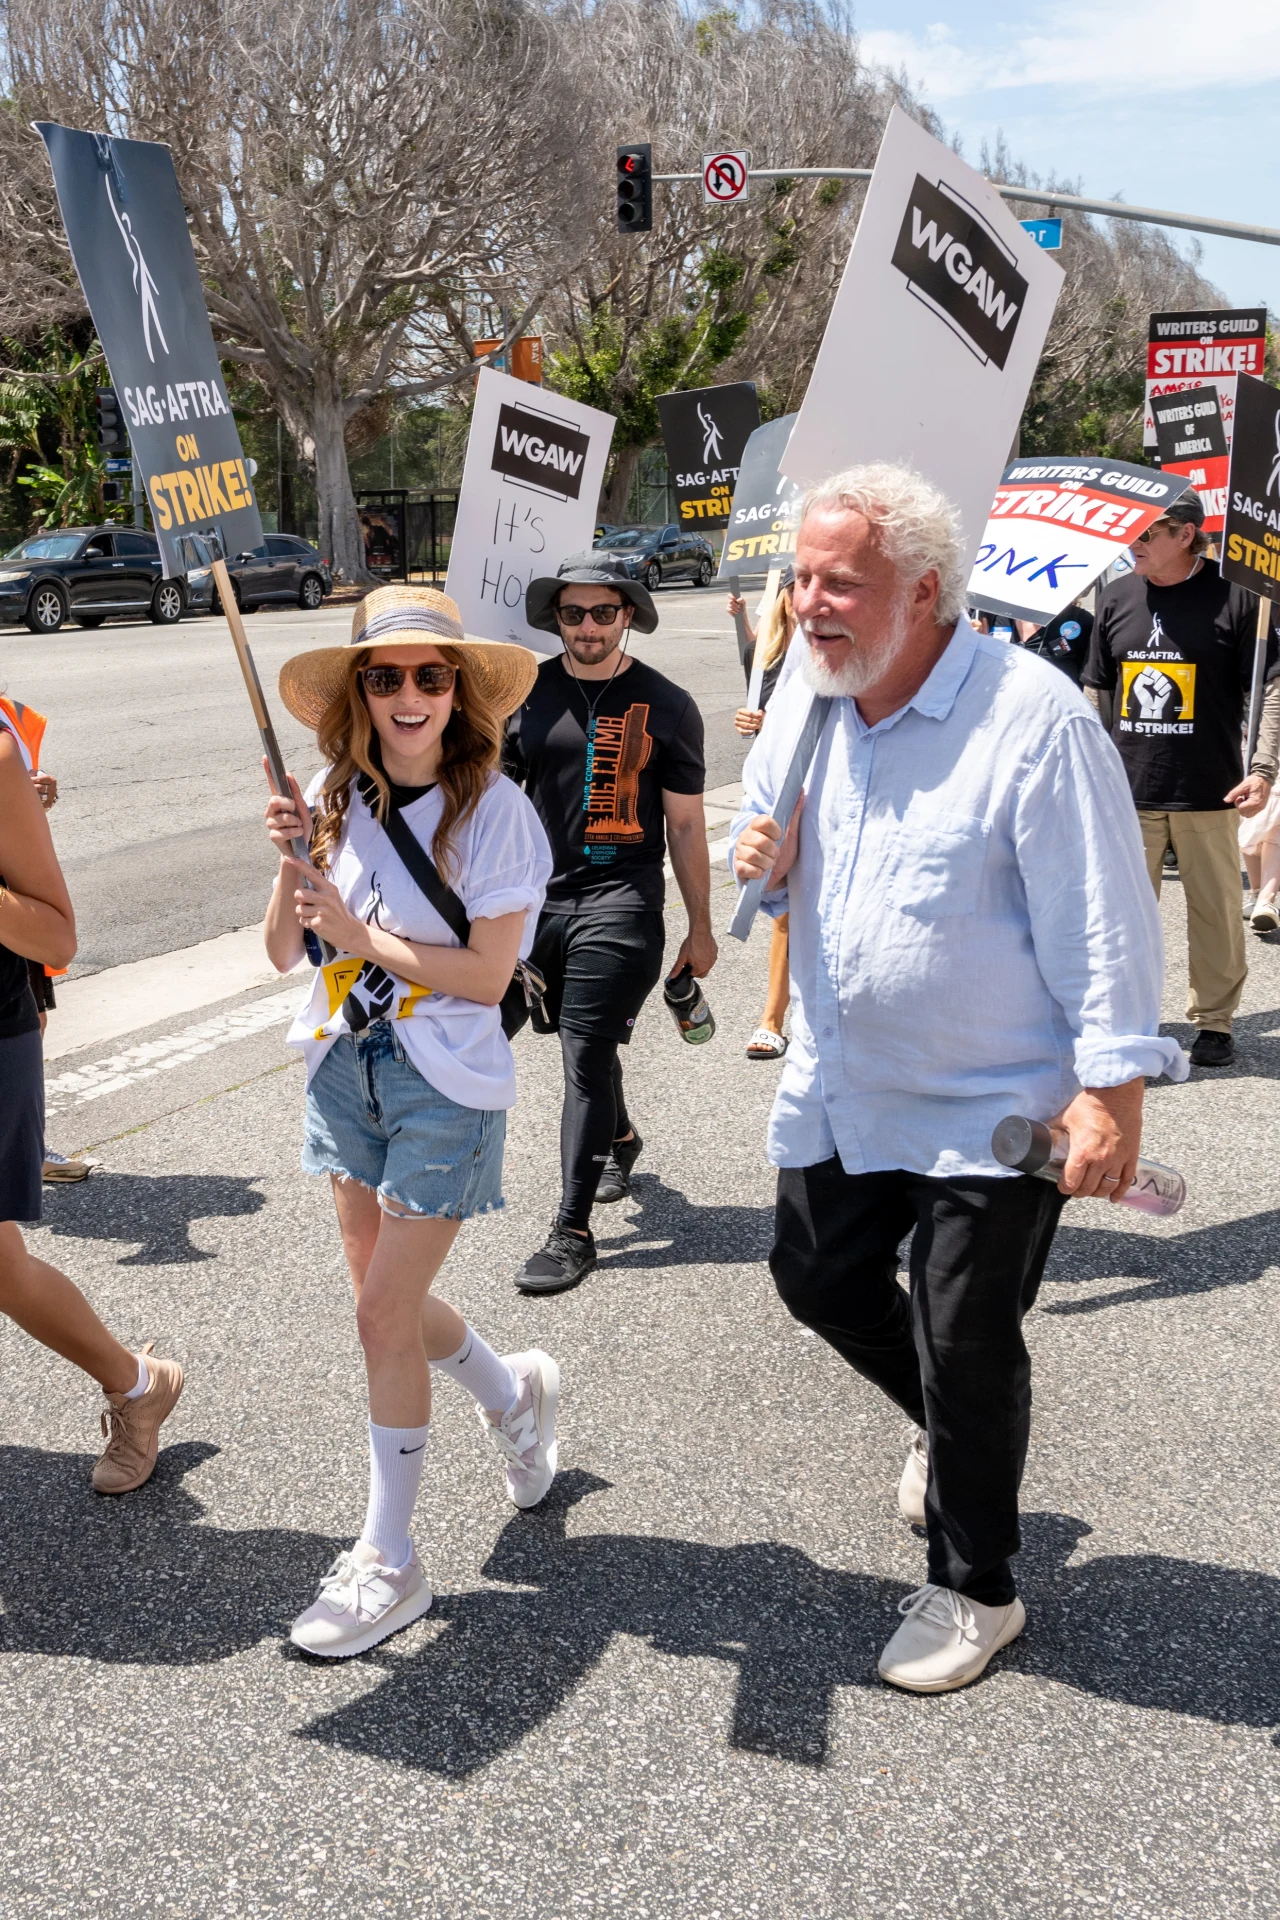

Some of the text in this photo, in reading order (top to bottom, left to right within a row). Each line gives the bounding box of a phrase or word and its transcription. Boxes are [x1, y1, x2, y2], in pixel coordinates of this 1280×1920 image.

[911, 205, 1019, 332] WGAW
[1156, 318, 1259, 336] WRITERS GUILD
[1199, 336, 1213, 345] ON
[531, 341, 540, 364] STAY
[1154, 343, 1257, 374] STRIKE!
[1156, 404, 1194, 425] WRITERS
[1194, 400, 1217, 417] GUILD
[1184, 423, 1195, 436] OF
[175, 433, 200, 462] ON
[500, 425, 584, 477] WGAW
[1174, 437, 1213, 457] AMERICA
[1007, 465, 1169, 499] WRITERS GUILD
[1059, 480, 1084, 491] ON
[1189, 468, 1207, 486] ON
[149, 458, 253, 531] STRIKE!
[710, 485, 730, 497] ON
[1263, 532, 1280, 552] ON
[1227, 533, 1280, 583] STRI
[1120, 719, 1194, 734] ON STRIKE!
[587, 716, 625, 812] BIG CLIMB
